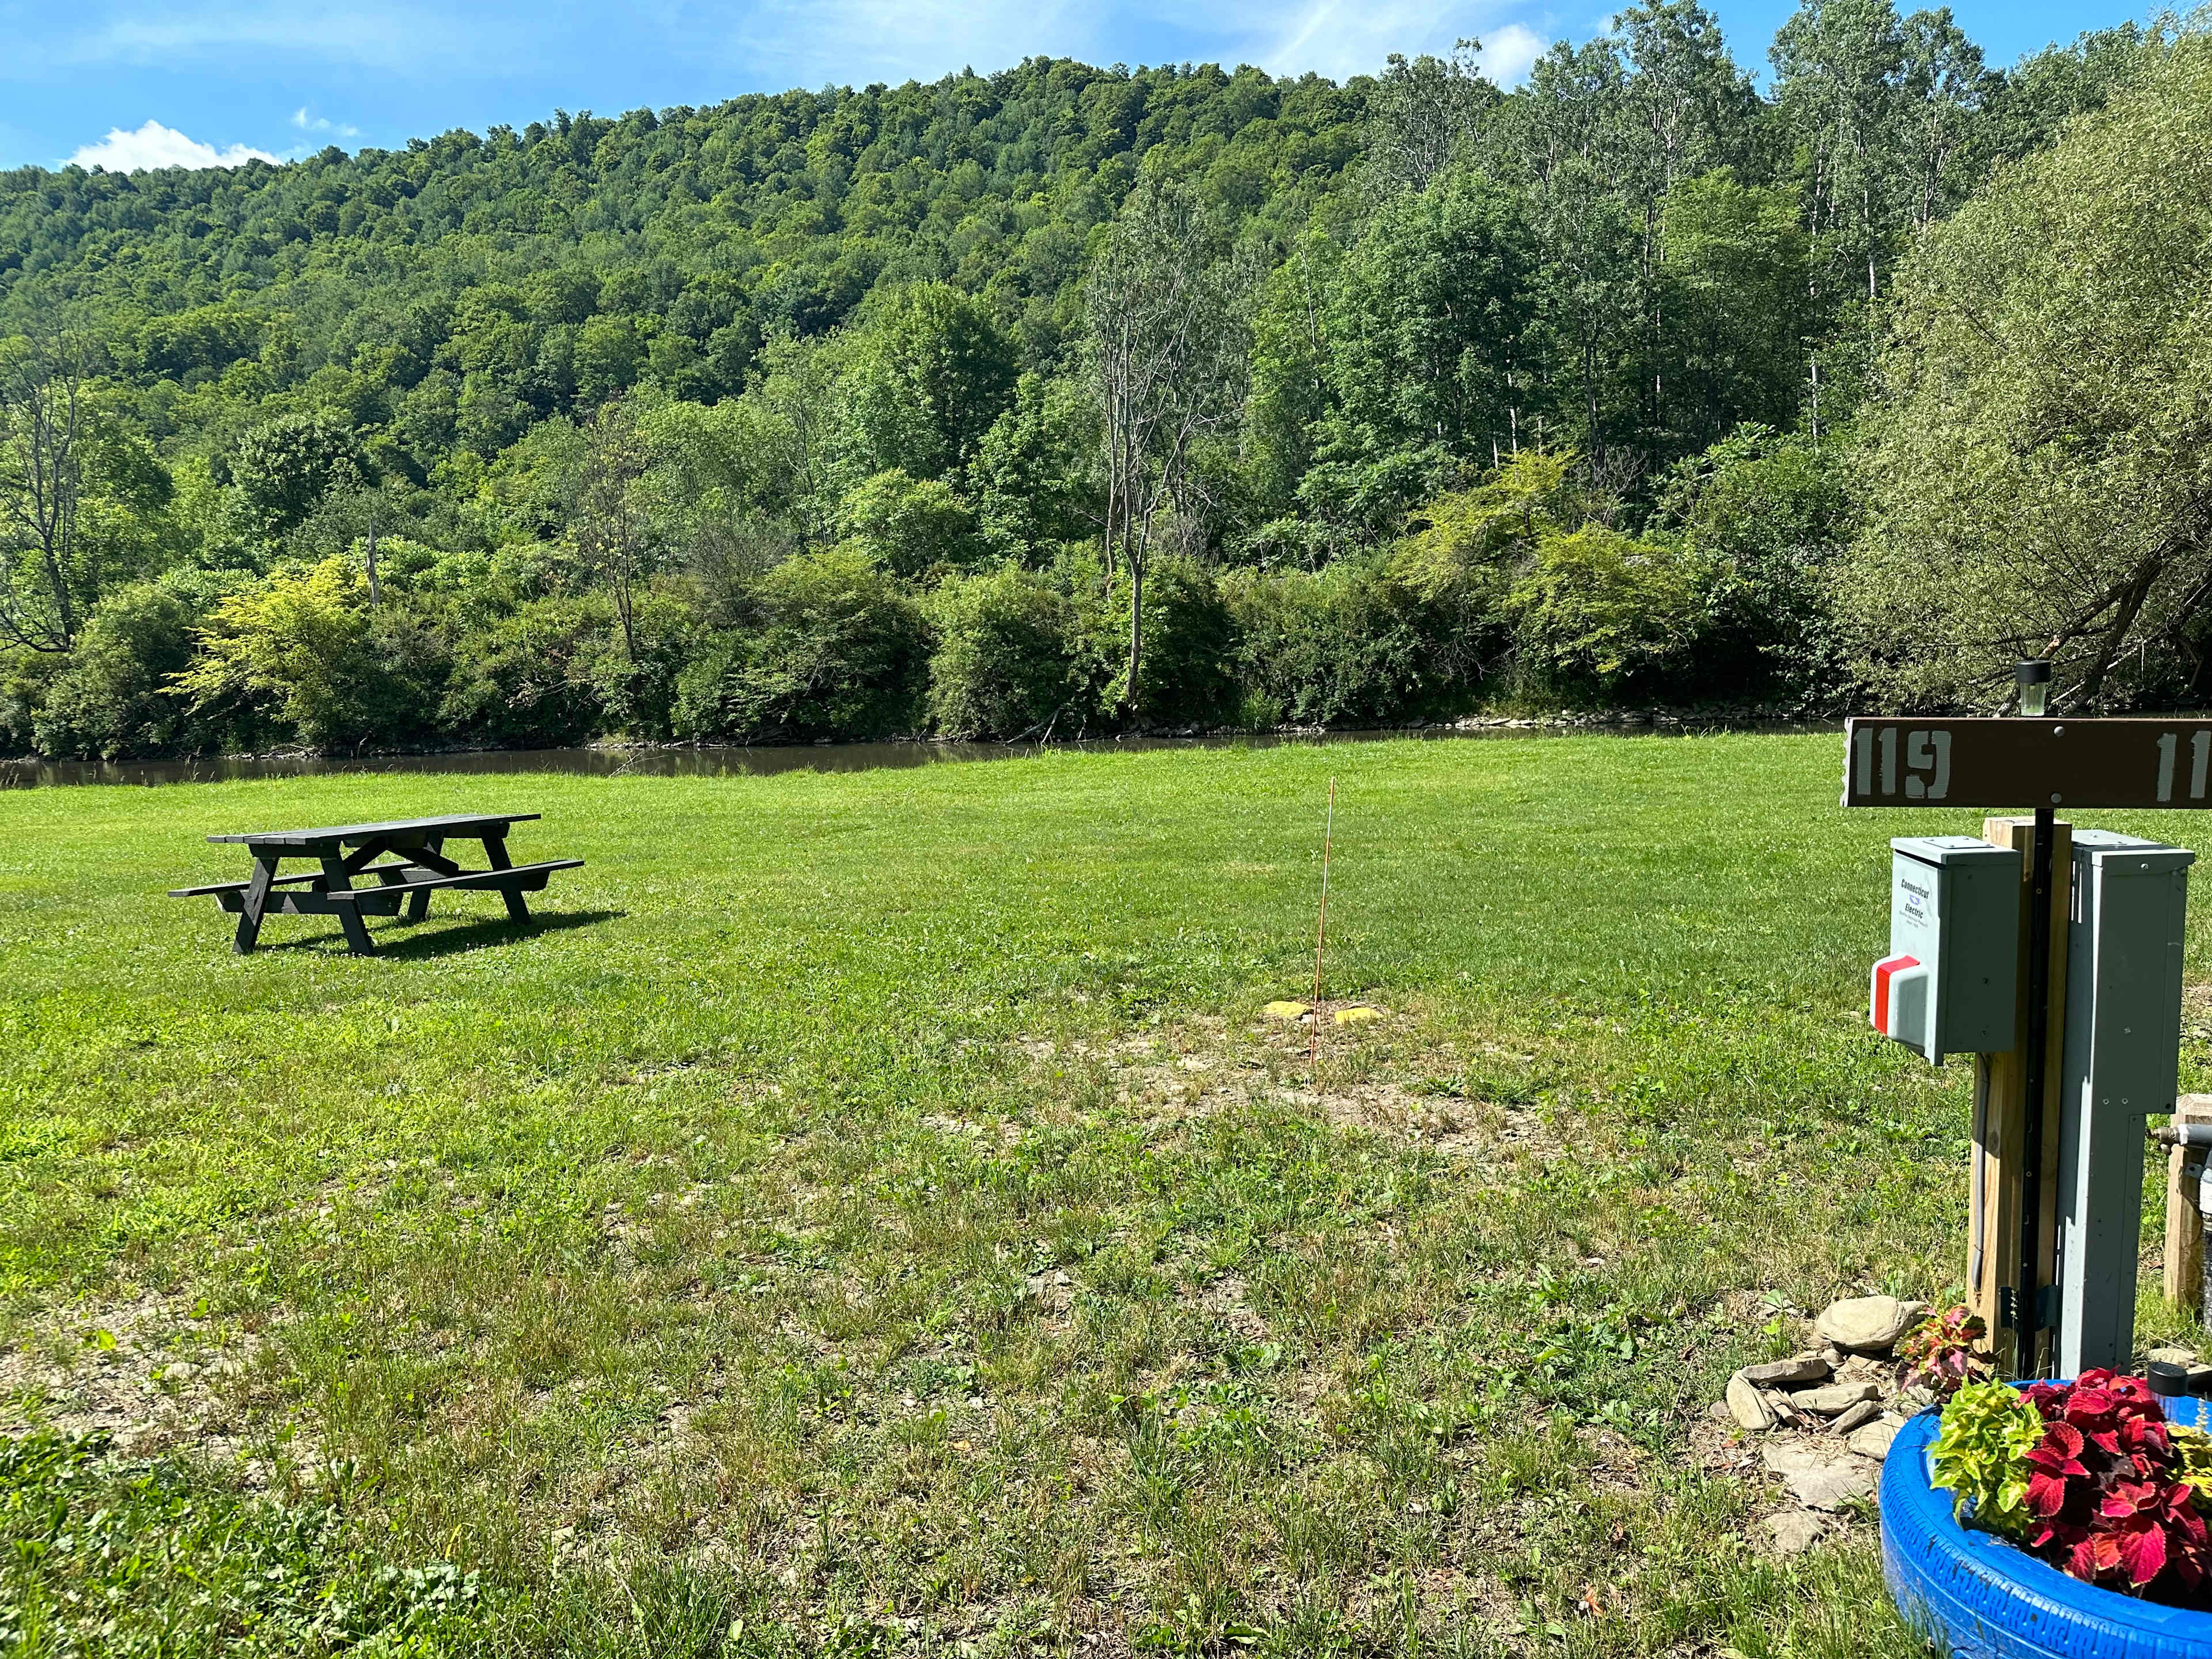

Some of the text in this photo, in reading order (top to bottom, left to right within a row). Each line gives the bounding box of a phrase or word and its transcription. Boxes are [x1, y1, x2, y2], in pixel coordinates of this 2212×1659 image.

[1853, 728, 1952, 799] 119
[1901, 878, 1929, 899] Connecticut
[1905, 903, 1923, 919] Electric
